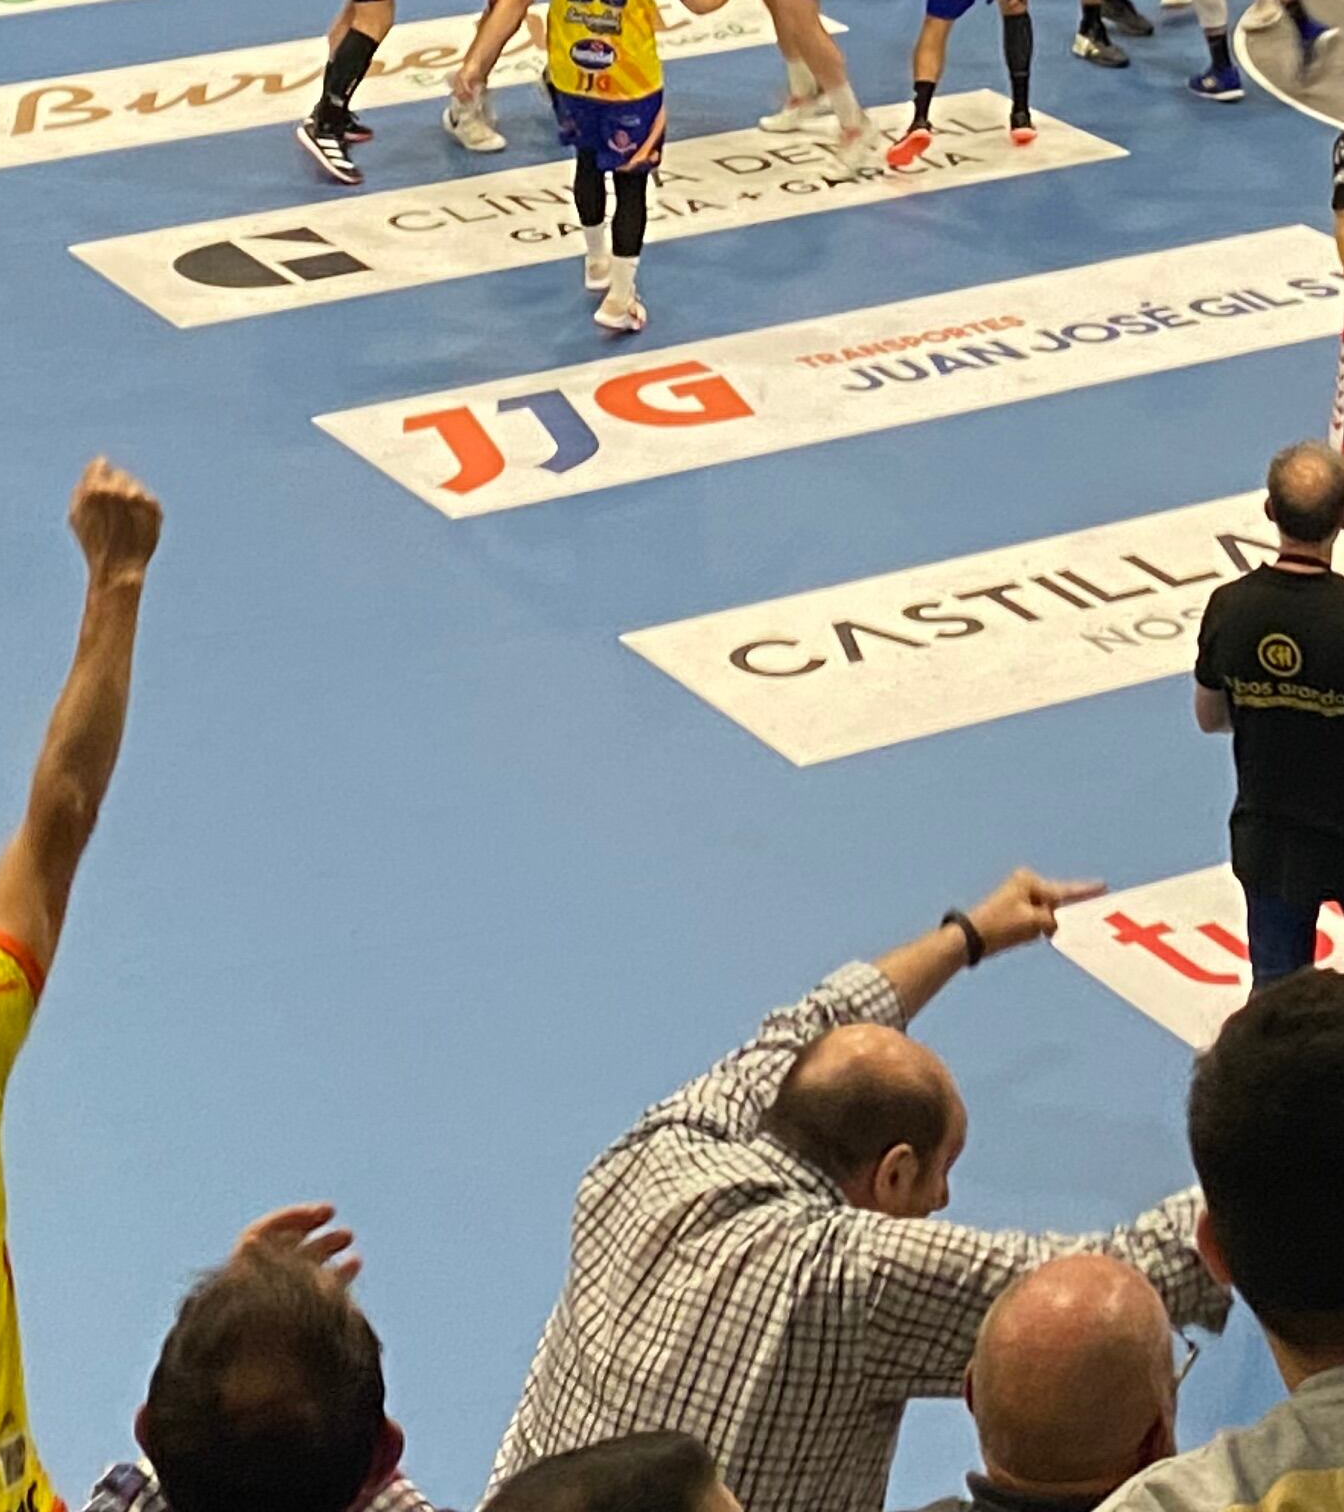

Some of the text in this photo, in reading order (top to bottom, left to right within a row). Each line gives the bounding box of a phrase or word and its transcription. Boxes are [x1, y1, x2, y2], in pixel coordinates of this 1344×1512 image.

[388, 118, 1005, 233] CLÍNA DENL
[794, 314, 1027, 370] TRANSPORTES
[841, 338, 1029, 392] JUAN
[1031, 300, 1201, 354] JOSÉ
[1189, 287, 1301, 318] GIL
[402, 360, 756, 496] JJG
